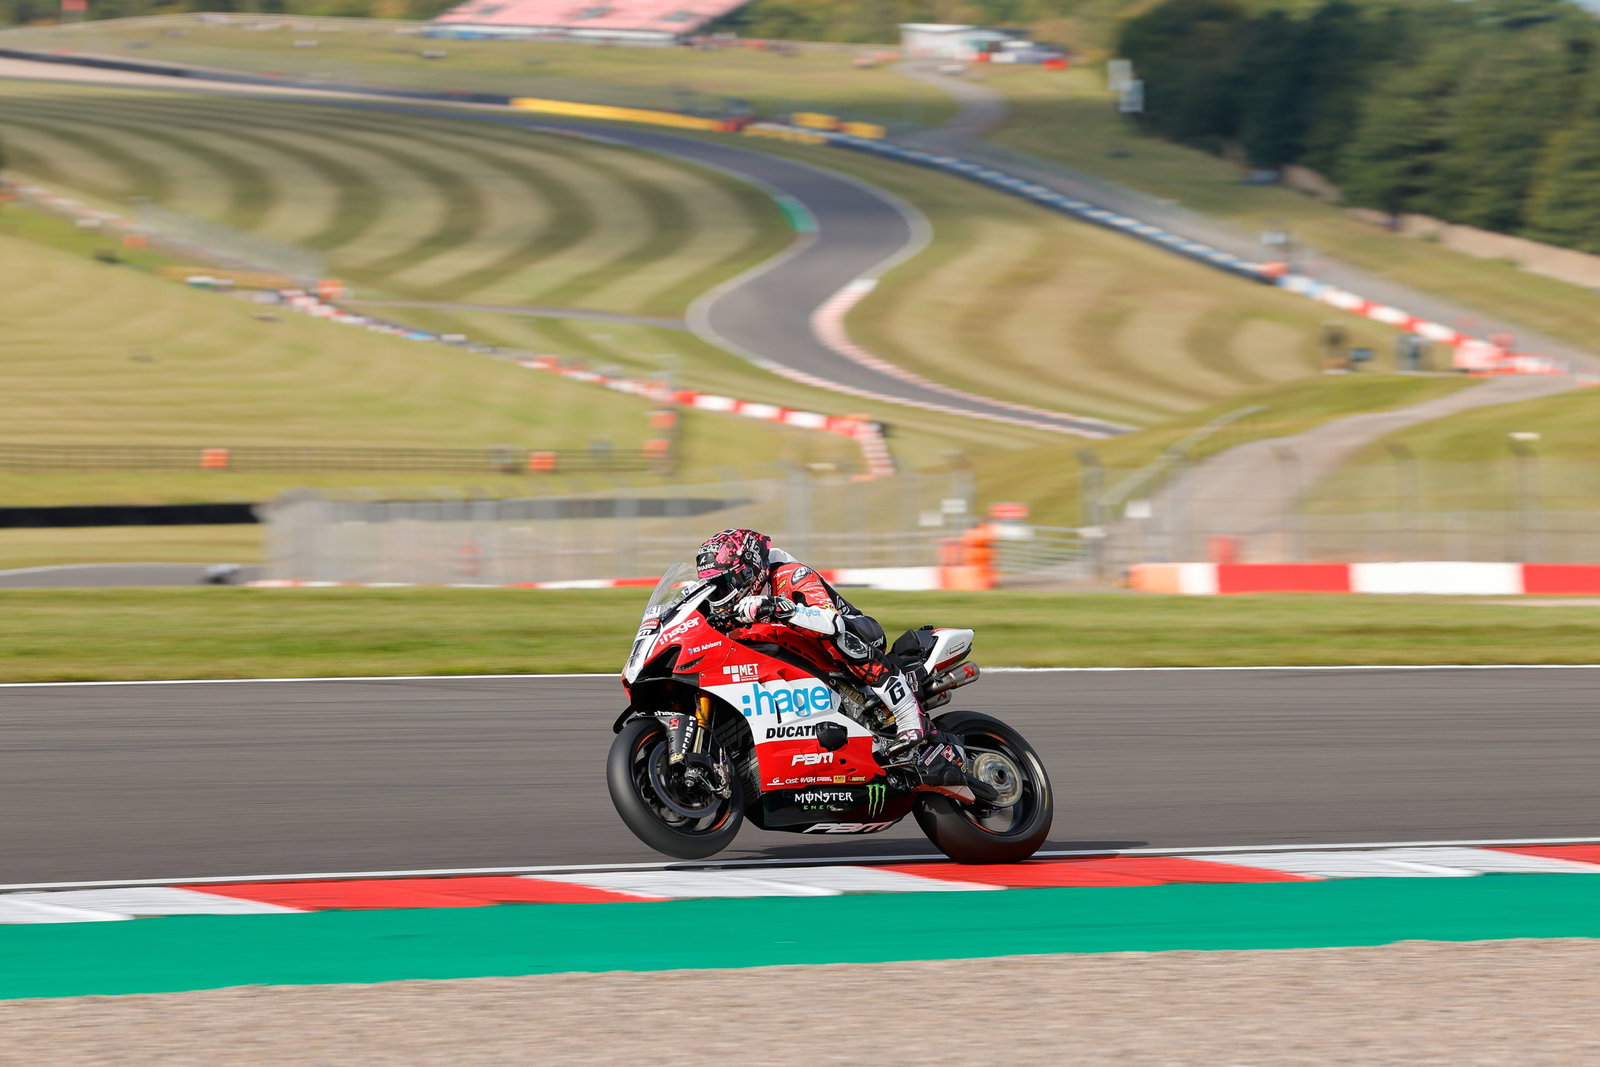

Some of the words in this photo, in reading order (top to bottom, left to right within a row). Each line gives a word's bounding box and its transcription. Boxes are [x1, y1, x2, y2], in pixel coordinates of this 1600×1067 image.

[702, 640, 722, 651] Advisory
[740, 663, 759, 676] MET
[766, 725, 816, 739] DUCATI
[794, 790, 853, 804] MONSTER
